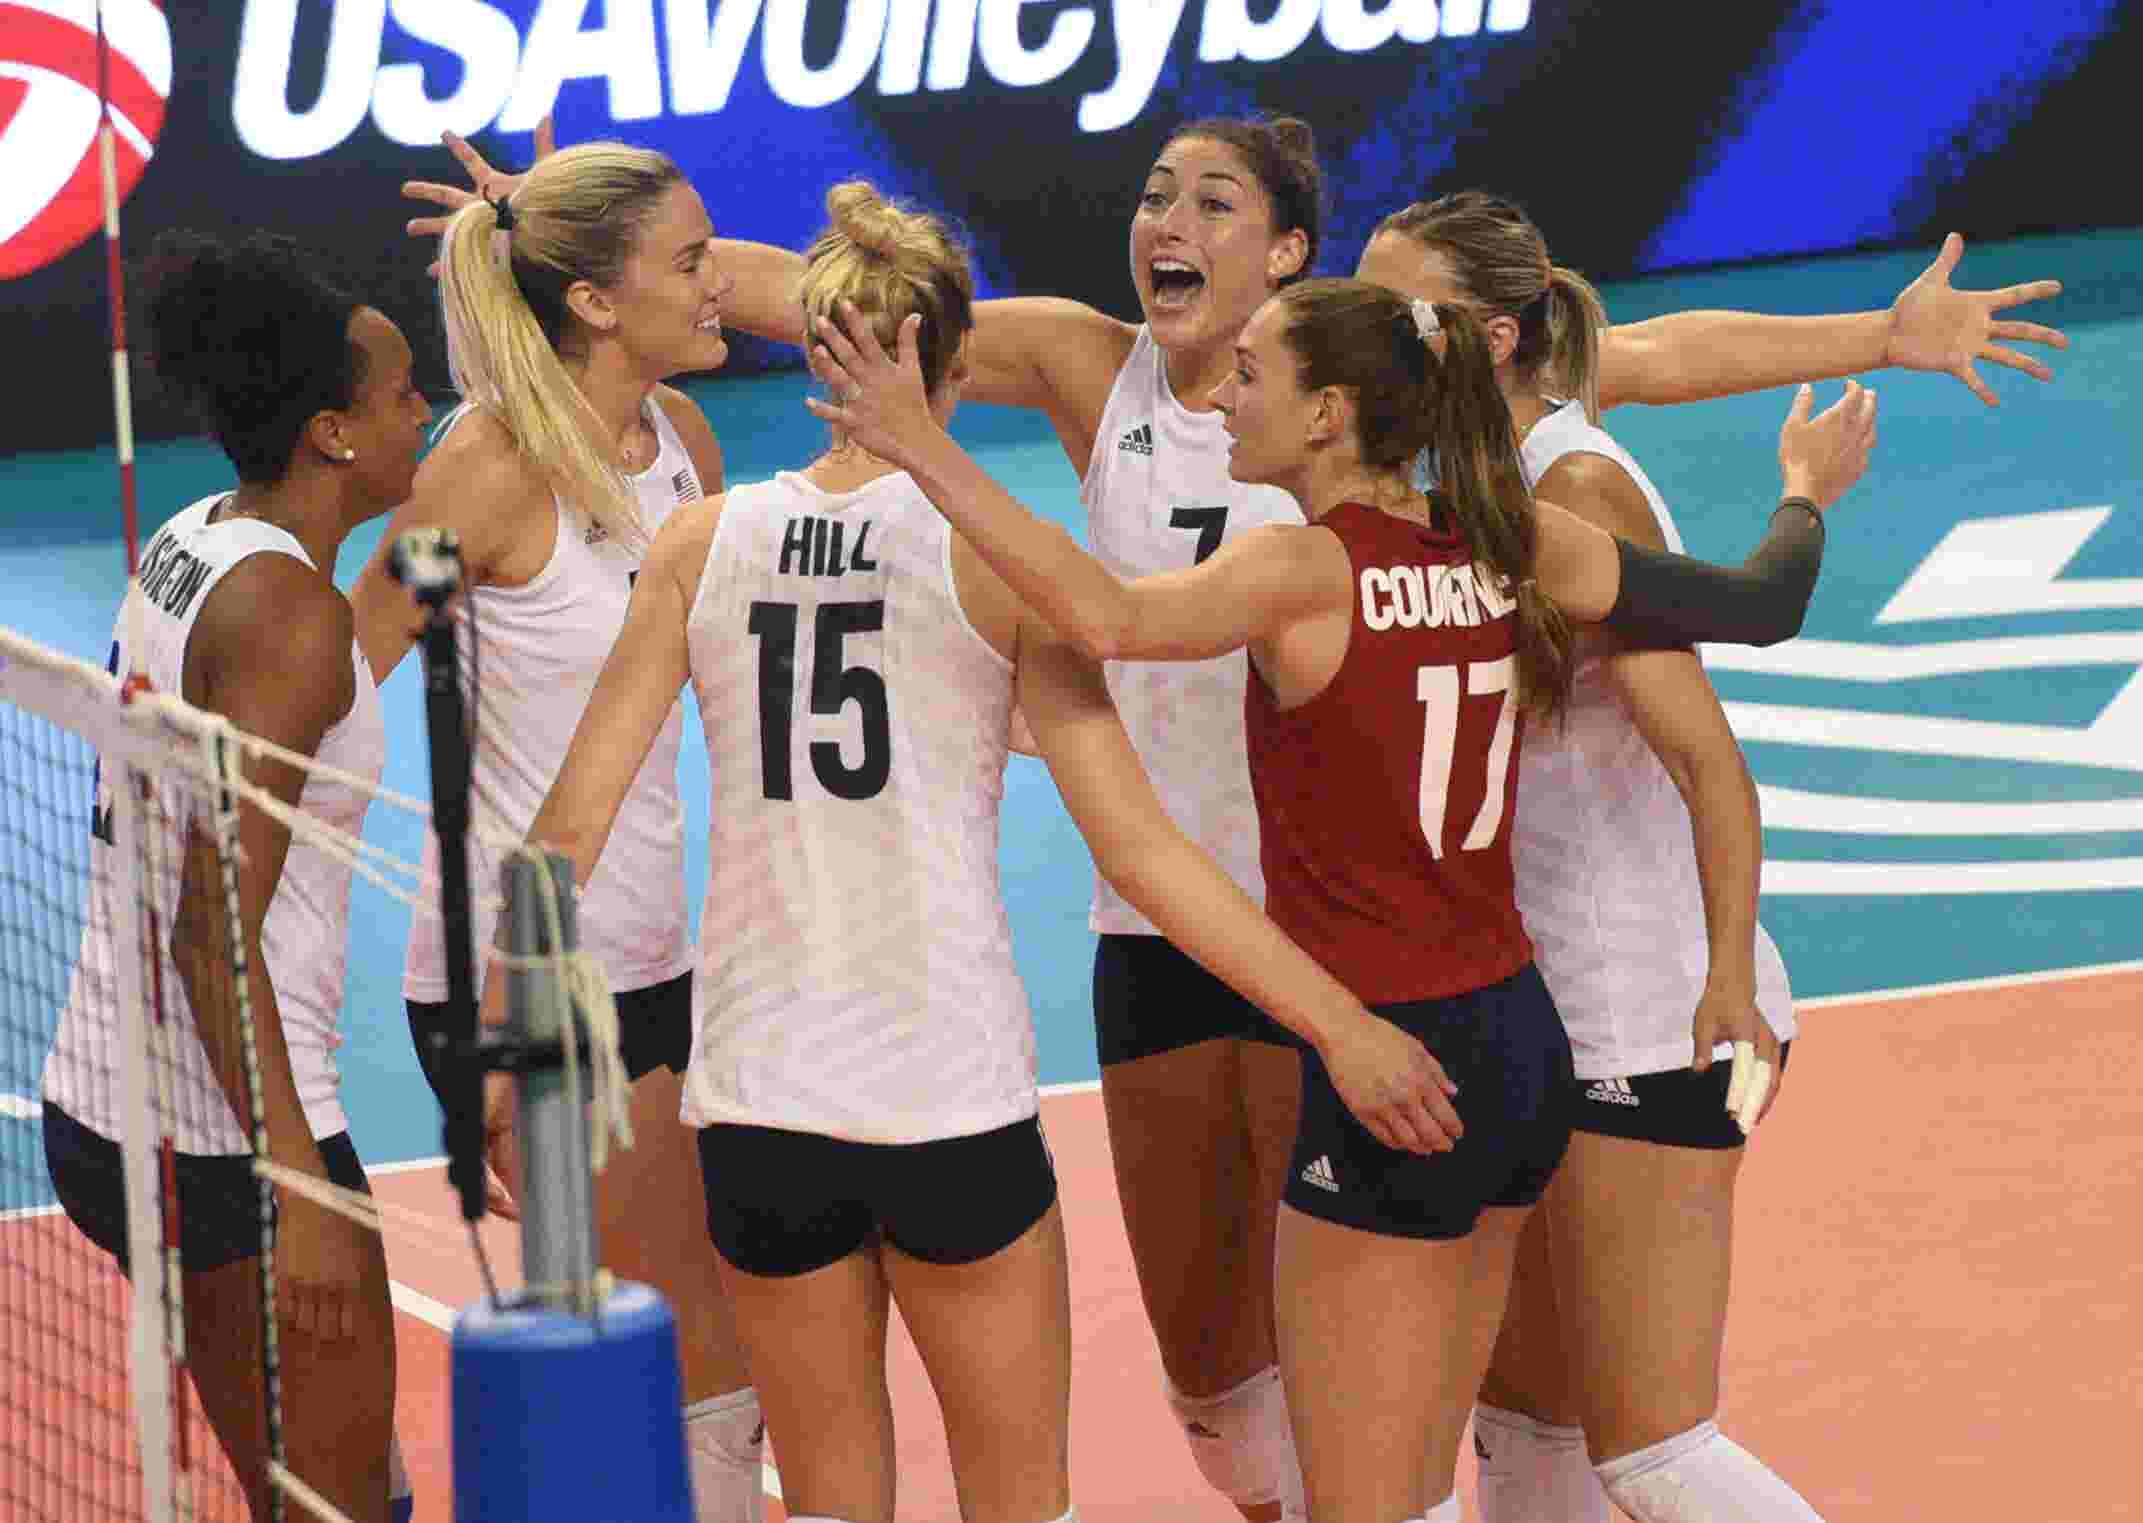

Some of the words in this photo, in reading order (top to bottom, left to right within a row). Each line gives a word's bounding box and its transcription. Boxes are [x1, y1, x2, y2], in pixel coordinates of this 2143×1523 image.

[231, 0, 1532, 160] USAVolley
[777, 515, 877, 577] HILL
[1168, 506, 1229, 566] 7
[747, 600, 891, 801] 15
[1416, 653, 1519, 861] 17
[1584, 1087, 1640, 1107] adidas
